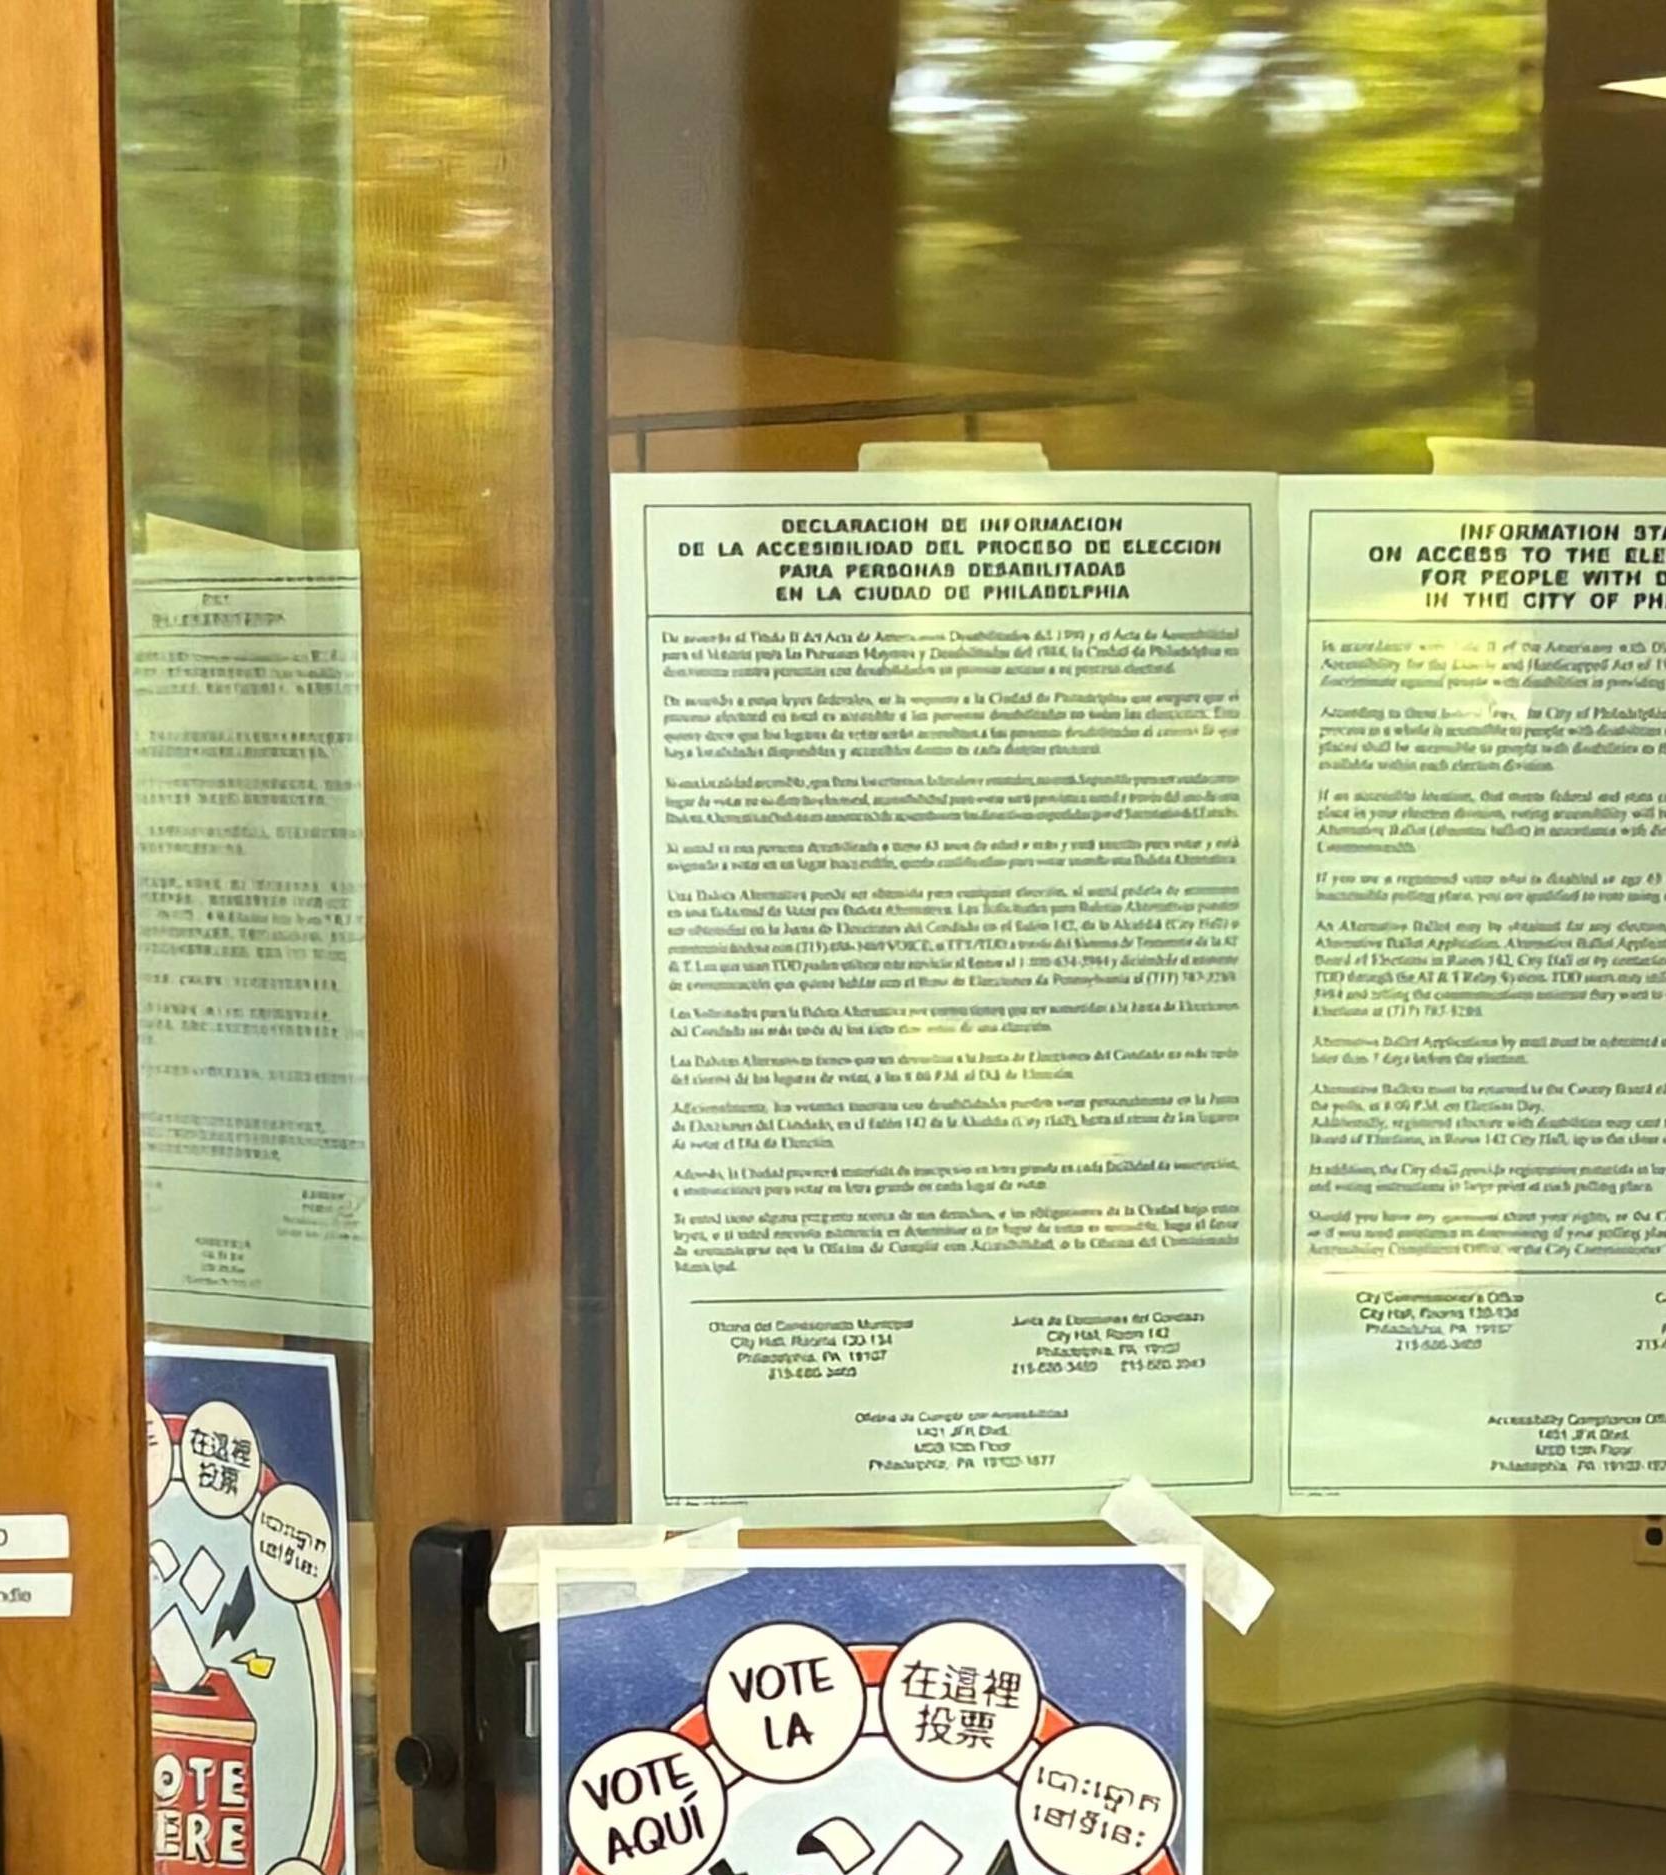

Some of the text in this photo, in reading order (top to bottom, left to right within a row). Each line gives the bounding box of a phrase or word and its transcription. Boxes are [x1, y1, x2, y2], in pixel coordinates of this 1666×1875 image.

[782, 517, 1122, 534] DECLARACION DE INFORMACION
[1460, 523, 1620, 541] INFORMATION
[678, 540, 1221, 556] DE LA ACCESIBILIDAD DEL PROCESO DE ELECCION
[1369, 546, 1402, 563] ON
[1416, 546, 1507, 563] ACCESS
[1522, 547, 1551, 563] TO
[1566, 546, 1610, 564] THE
[779, 562, 1126, 578] PARA PERSONAS DESABILITADAS
[1421, 569, 1466, 586] FOR
[1481, 569, 1569, 586] PEOPLE
[1582, 570, 1641, 587] WITH
[776, 585, 1129, 601] EN LA CIUDAD DE PHILADELPHIA
[1426, 593, 1448, 608] IN
[1464, 593, 1509, 608] THE
[1524, 593, 1576, 610] CITY
[1589, 593, 1619, 610] OF
[1360, 1308, 1384, 1321] City
[728, 1656, 834, 1703] VOTE
[901, 1660, 1021, 1710] 在這裡
[764, 1712, 814, 1750] LA
[915, 1704, 996, 1749] 投票
[153, 1753, 247, 1811] OTE
[582, 1752, 694, 1811] VOTE
[607, 1790, 705, 1865] AQUÍ
[155, 1808, 248, 1868] ERE
